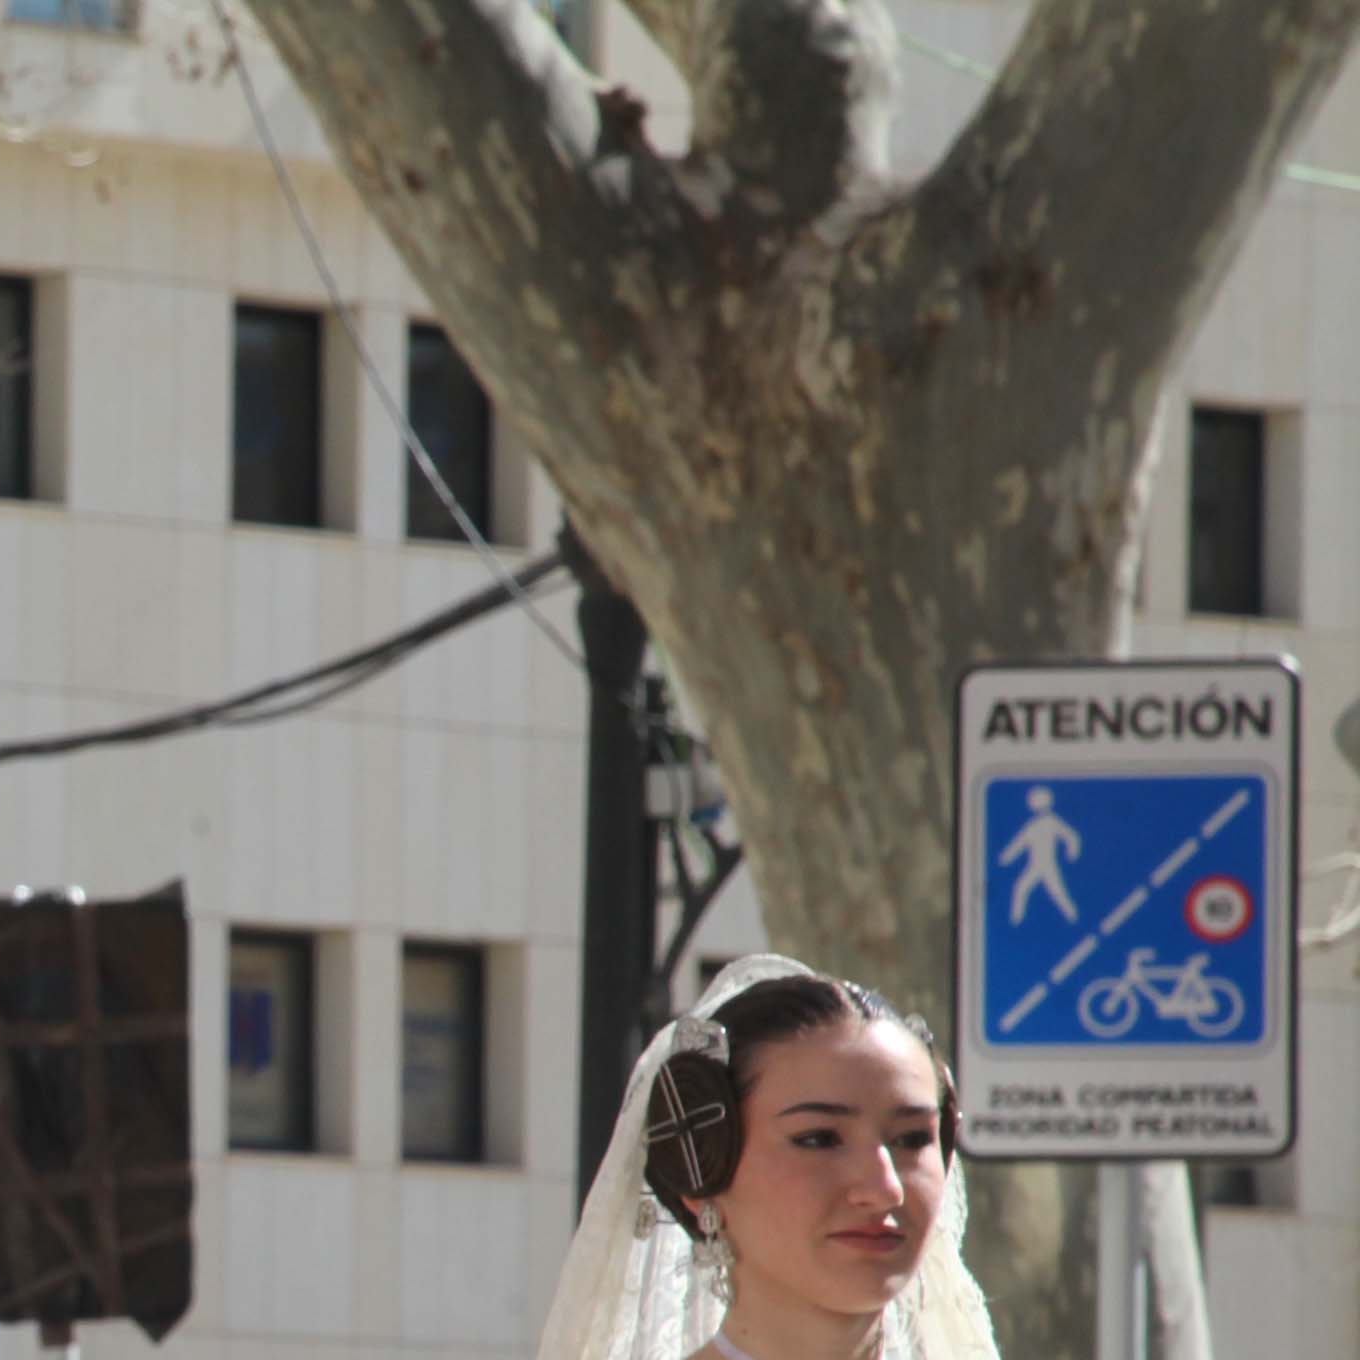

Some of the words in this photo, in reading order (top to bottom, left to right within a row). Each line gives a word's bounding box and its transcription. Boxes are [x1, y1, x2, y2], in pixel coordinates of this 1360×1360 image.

[984, 683, 1273, 742] ATENCIÓN
[988, 1083, 1065, 1109] ZONA
[1077, 1083, 1259, 1108] COMPARTIDA
[971, 1113, 1120, 1139] PRIORIDAD
[1132, 1113, 1274, 1139] PEATONAL
